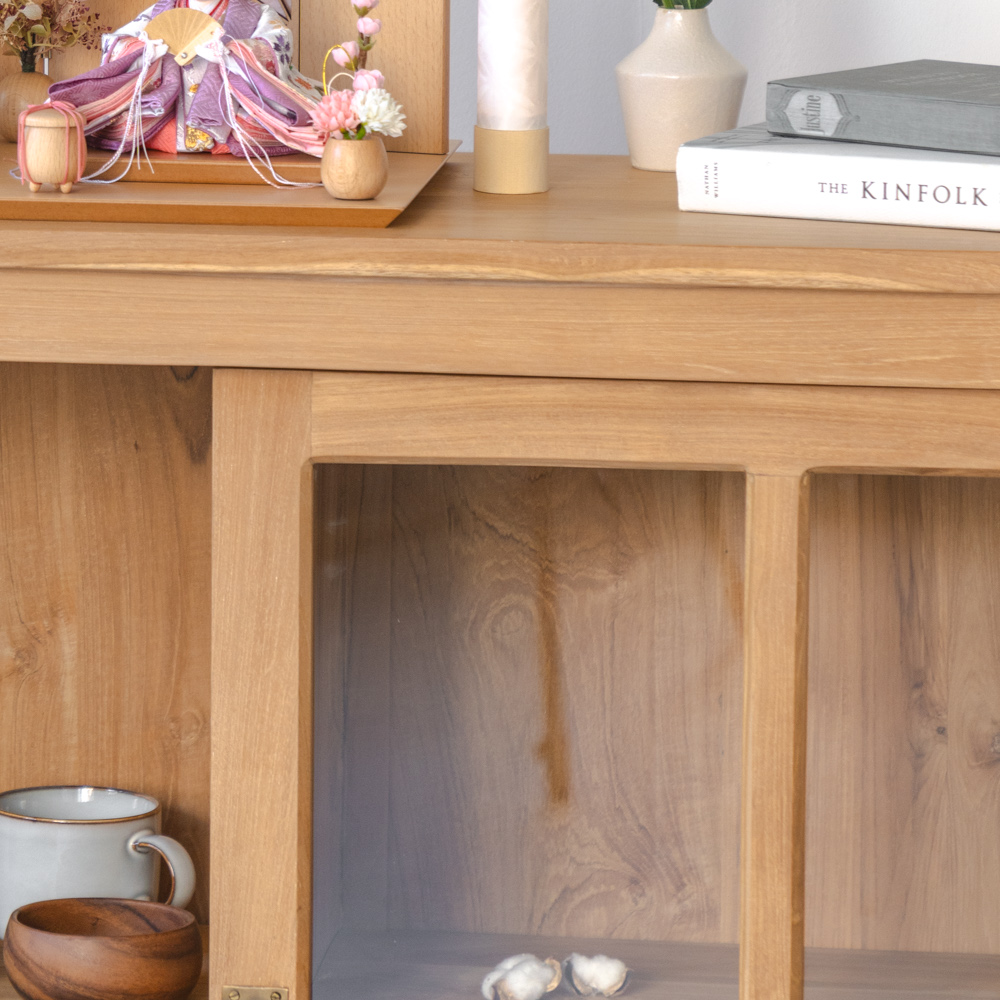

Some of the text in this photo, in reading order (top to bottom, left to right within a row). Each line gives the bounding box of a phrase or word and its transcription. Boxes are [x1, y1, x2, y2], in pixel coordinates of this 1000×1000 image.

[800, 94, 826, 135] Justine
[818, 181, 988, 206] THE KINFOLK
